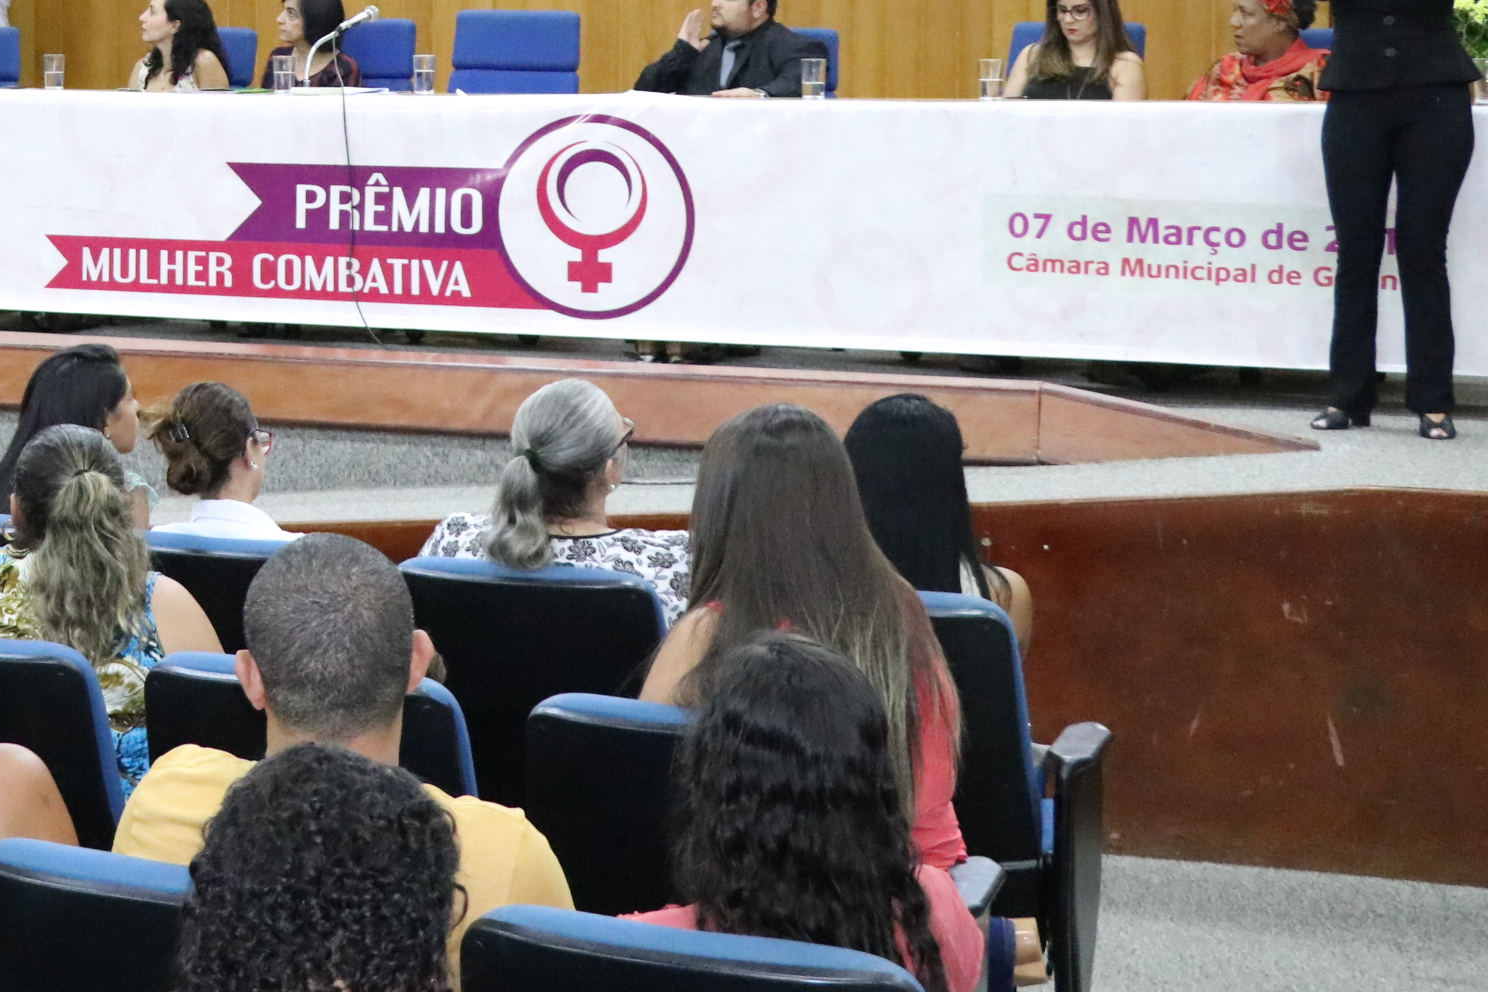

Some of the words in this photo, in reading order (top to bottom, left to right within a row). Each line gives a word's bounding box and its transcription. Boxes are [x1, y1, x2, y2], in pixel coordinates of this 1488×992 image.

[295, 172, 483, 235] PRÊMIO
[1007, 212, 1053, 239] 07
[1066, 214, 1112, 242] de
[1125, 216, 1247, 255] Março
[1261, 222, 1310, 251] de
[81, 247, 233, 287] MULHER
[252, 253, 472, 298] COMBATIVA
[1006, 251, 1110, 276] Câmara
[1120, 257, 1256, 286] Municipal
[1267, 265, 1303, 286] de
